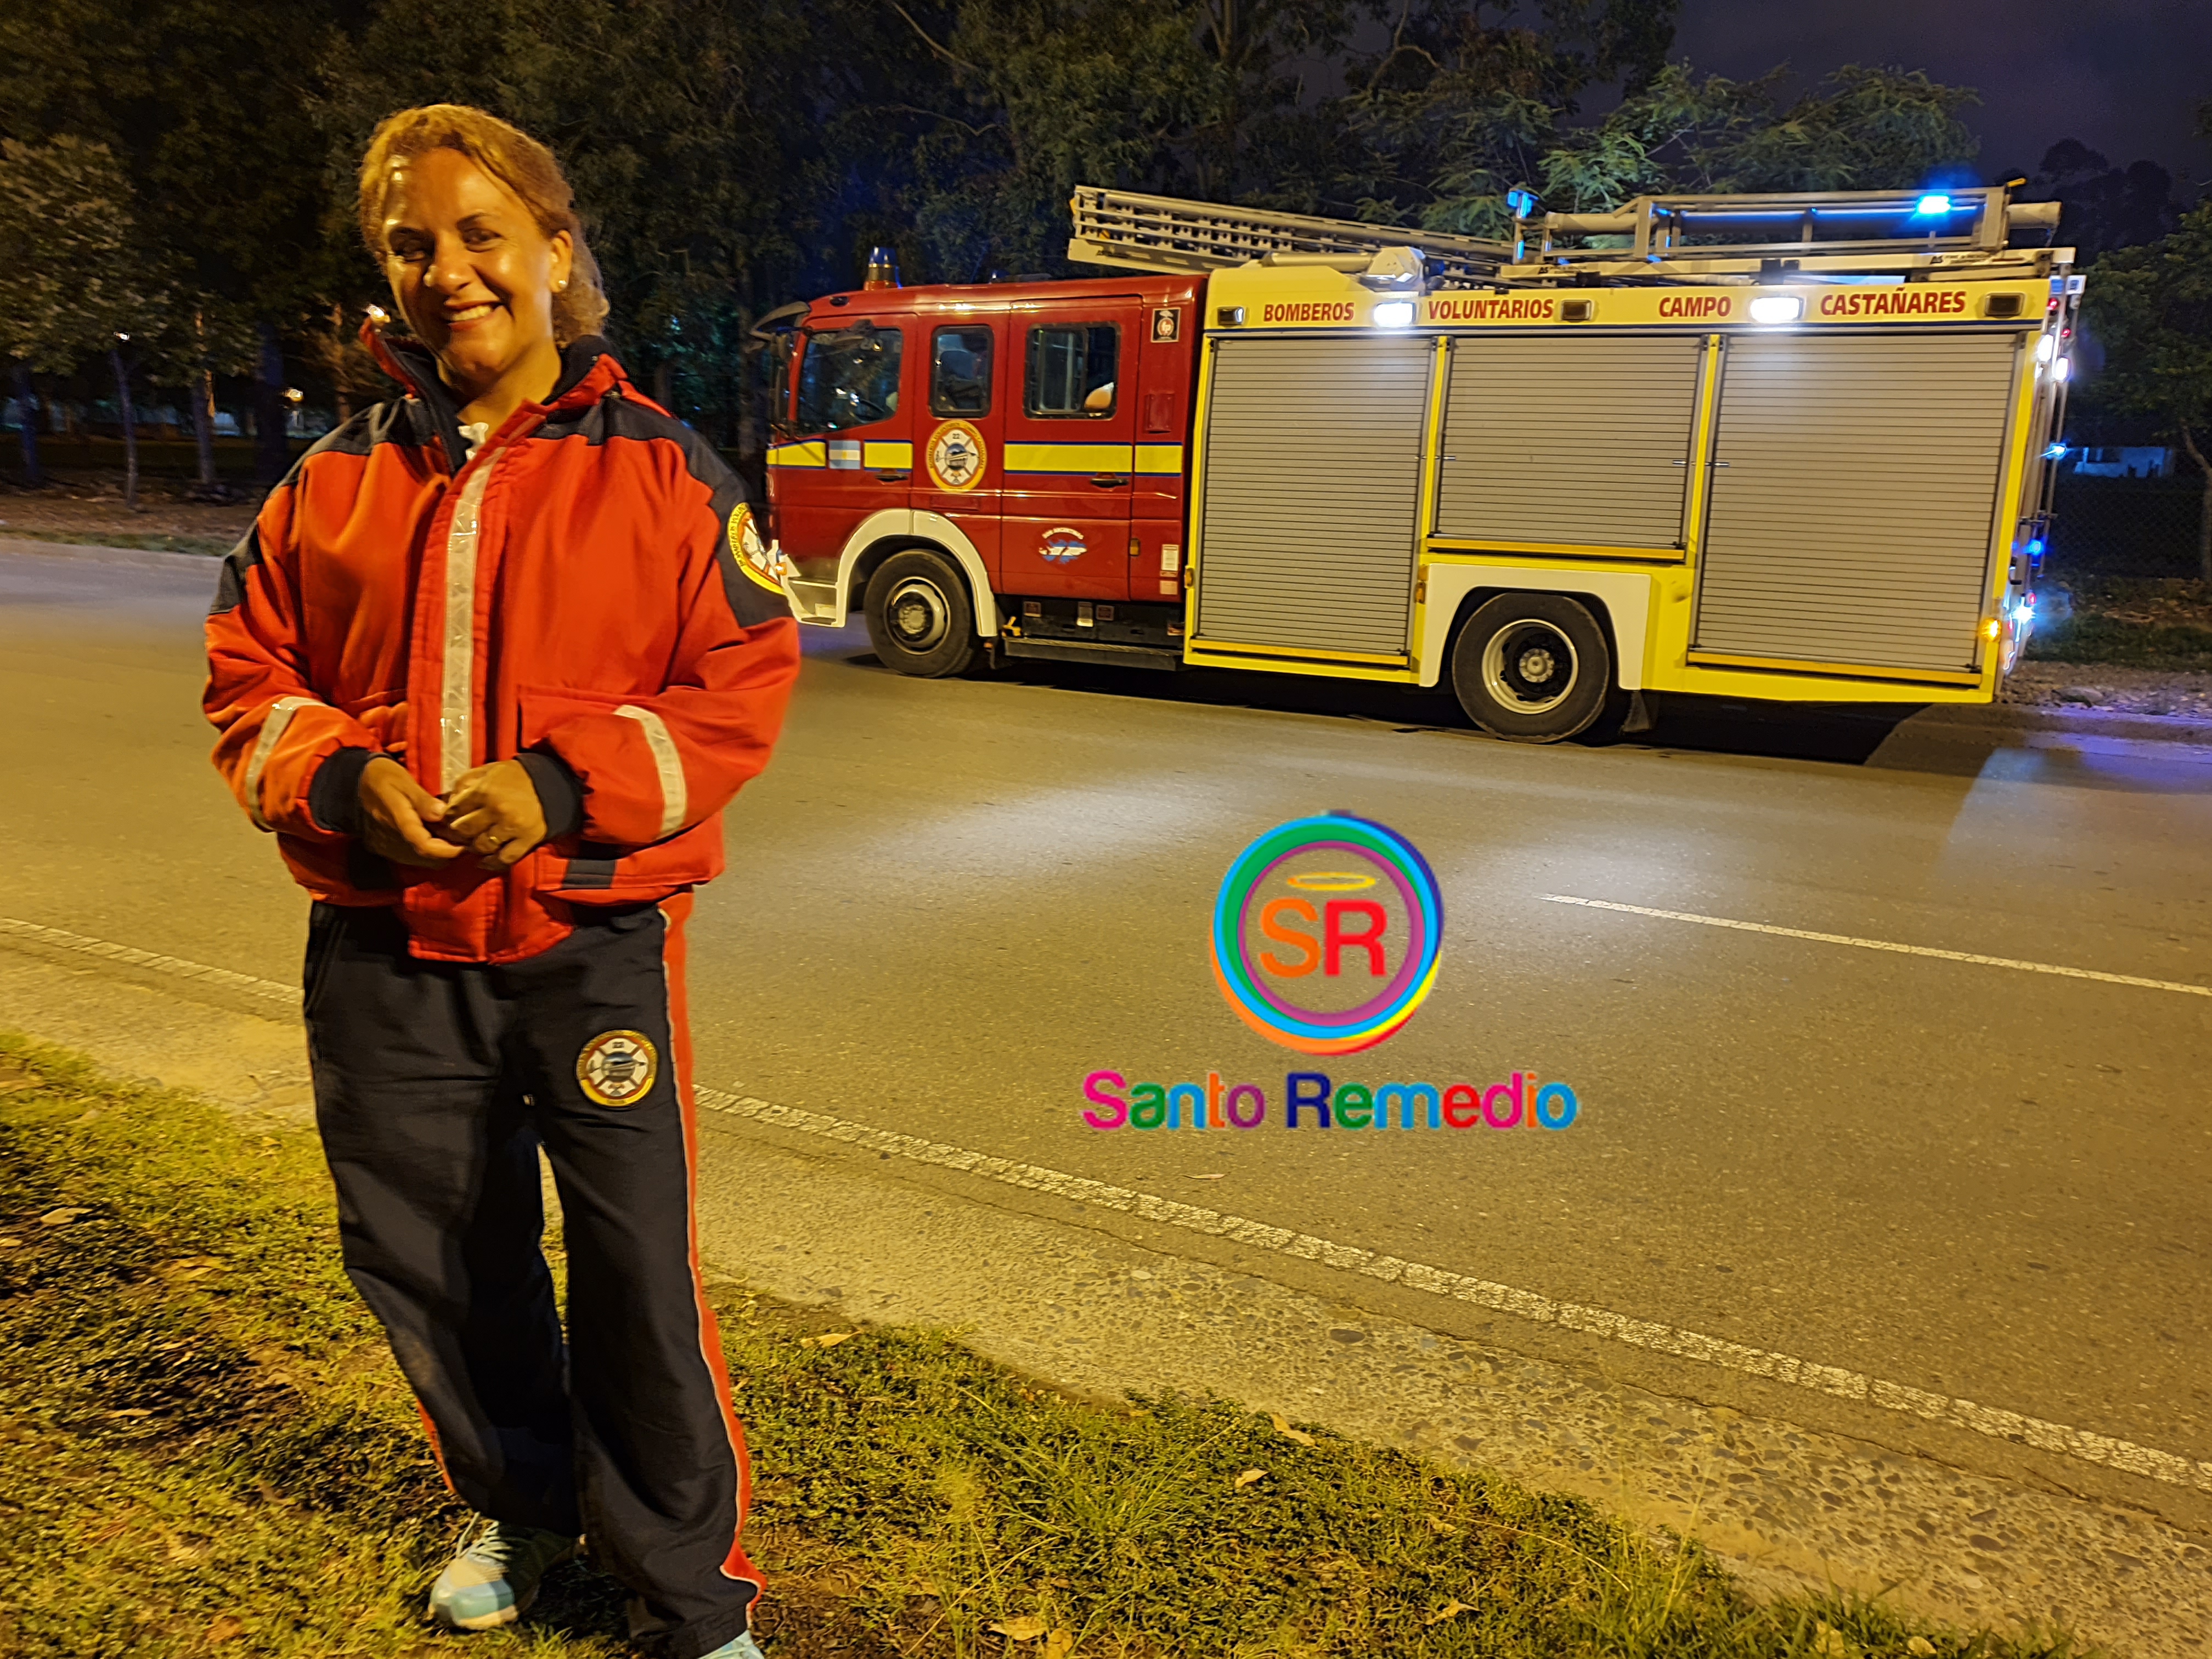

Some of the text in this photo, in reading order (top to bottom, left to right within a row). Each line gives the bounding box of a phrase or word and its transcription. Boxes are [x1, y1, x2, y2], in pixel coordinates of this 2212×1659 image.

[1263, 287, 1966, 322] BOMBEROS VOLUNTARIOS CAMPO CASTAÑARES
